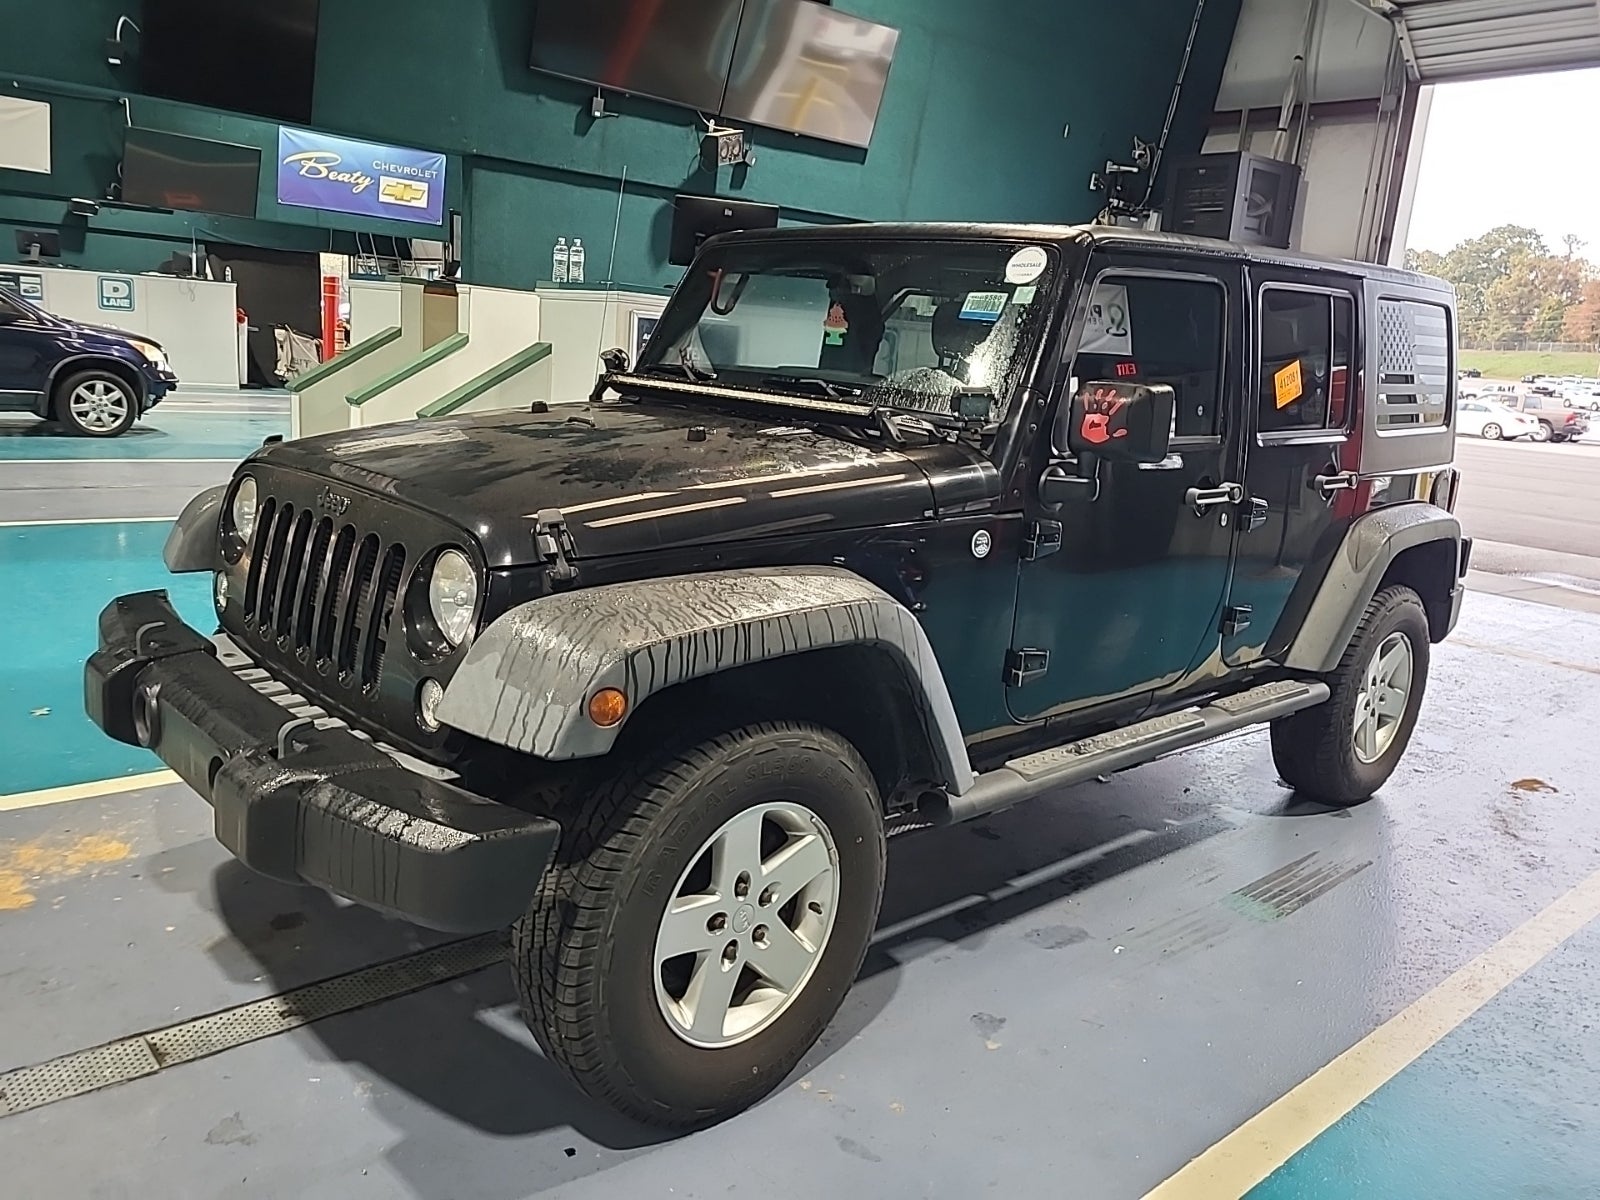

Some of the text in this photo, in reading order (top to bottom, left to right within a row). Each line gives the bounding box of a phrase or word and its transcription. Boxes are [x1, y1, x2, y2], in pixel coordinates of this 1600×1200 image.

[283, 151, 375, 194] Beaty
[373, 160, 438, 179] CHEVROLET
[102, 280, 130, 298] D
[102, 297, 131, 307] LANE
[317, 485, 352, 517] Jeep
